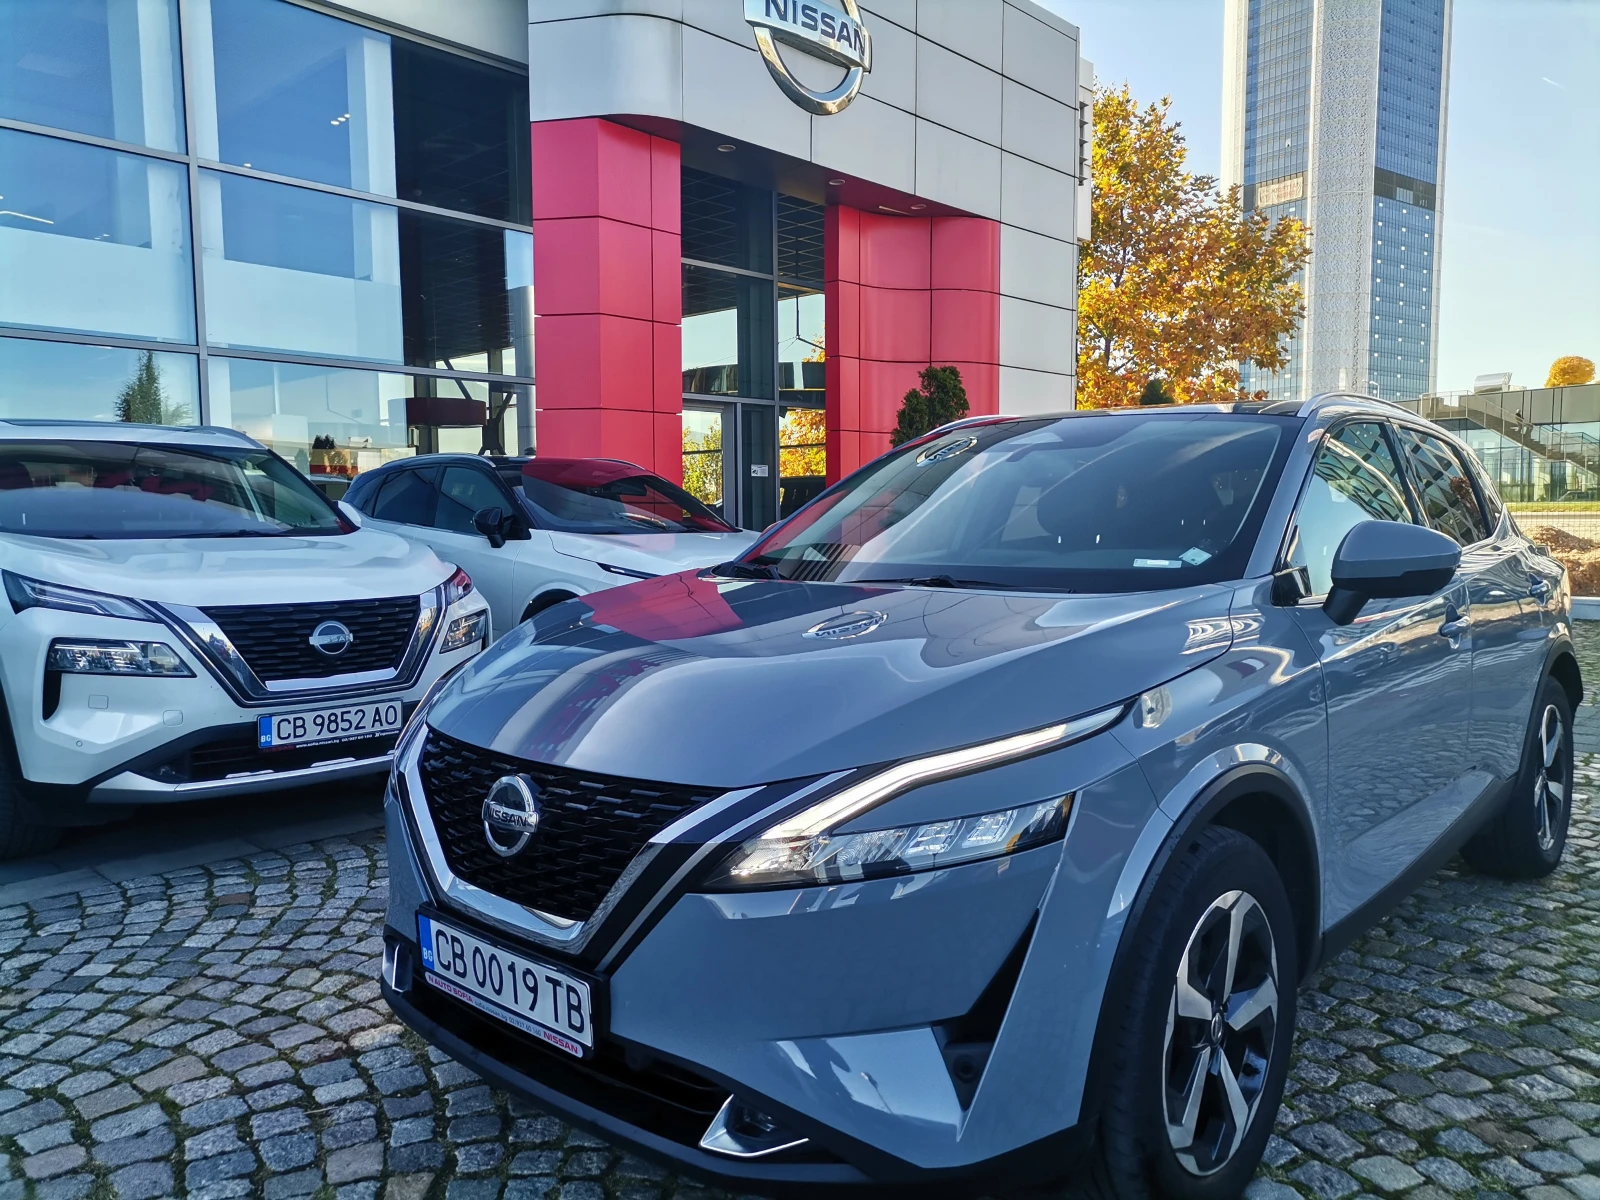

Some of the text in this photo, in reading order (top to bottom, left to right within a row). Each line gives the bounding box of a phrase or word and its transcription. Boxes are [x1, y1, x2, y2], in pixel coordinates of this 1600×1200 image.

[765, 0, 866, 57] NISSAN
[260, 734, 272, 743] BG
[276, 705, 398, 741] CB 9852 AO
[487, 806, 527, 827] NISSAN
[422, 948, 433, 963] BG
[435, 929, 585, 1034] CB 0019 TB
[434, 978, 452, 993] AUTO
[452, 987, 474, 1004] SOFIA
[543, 1030, 579, 1055] NISSAN
